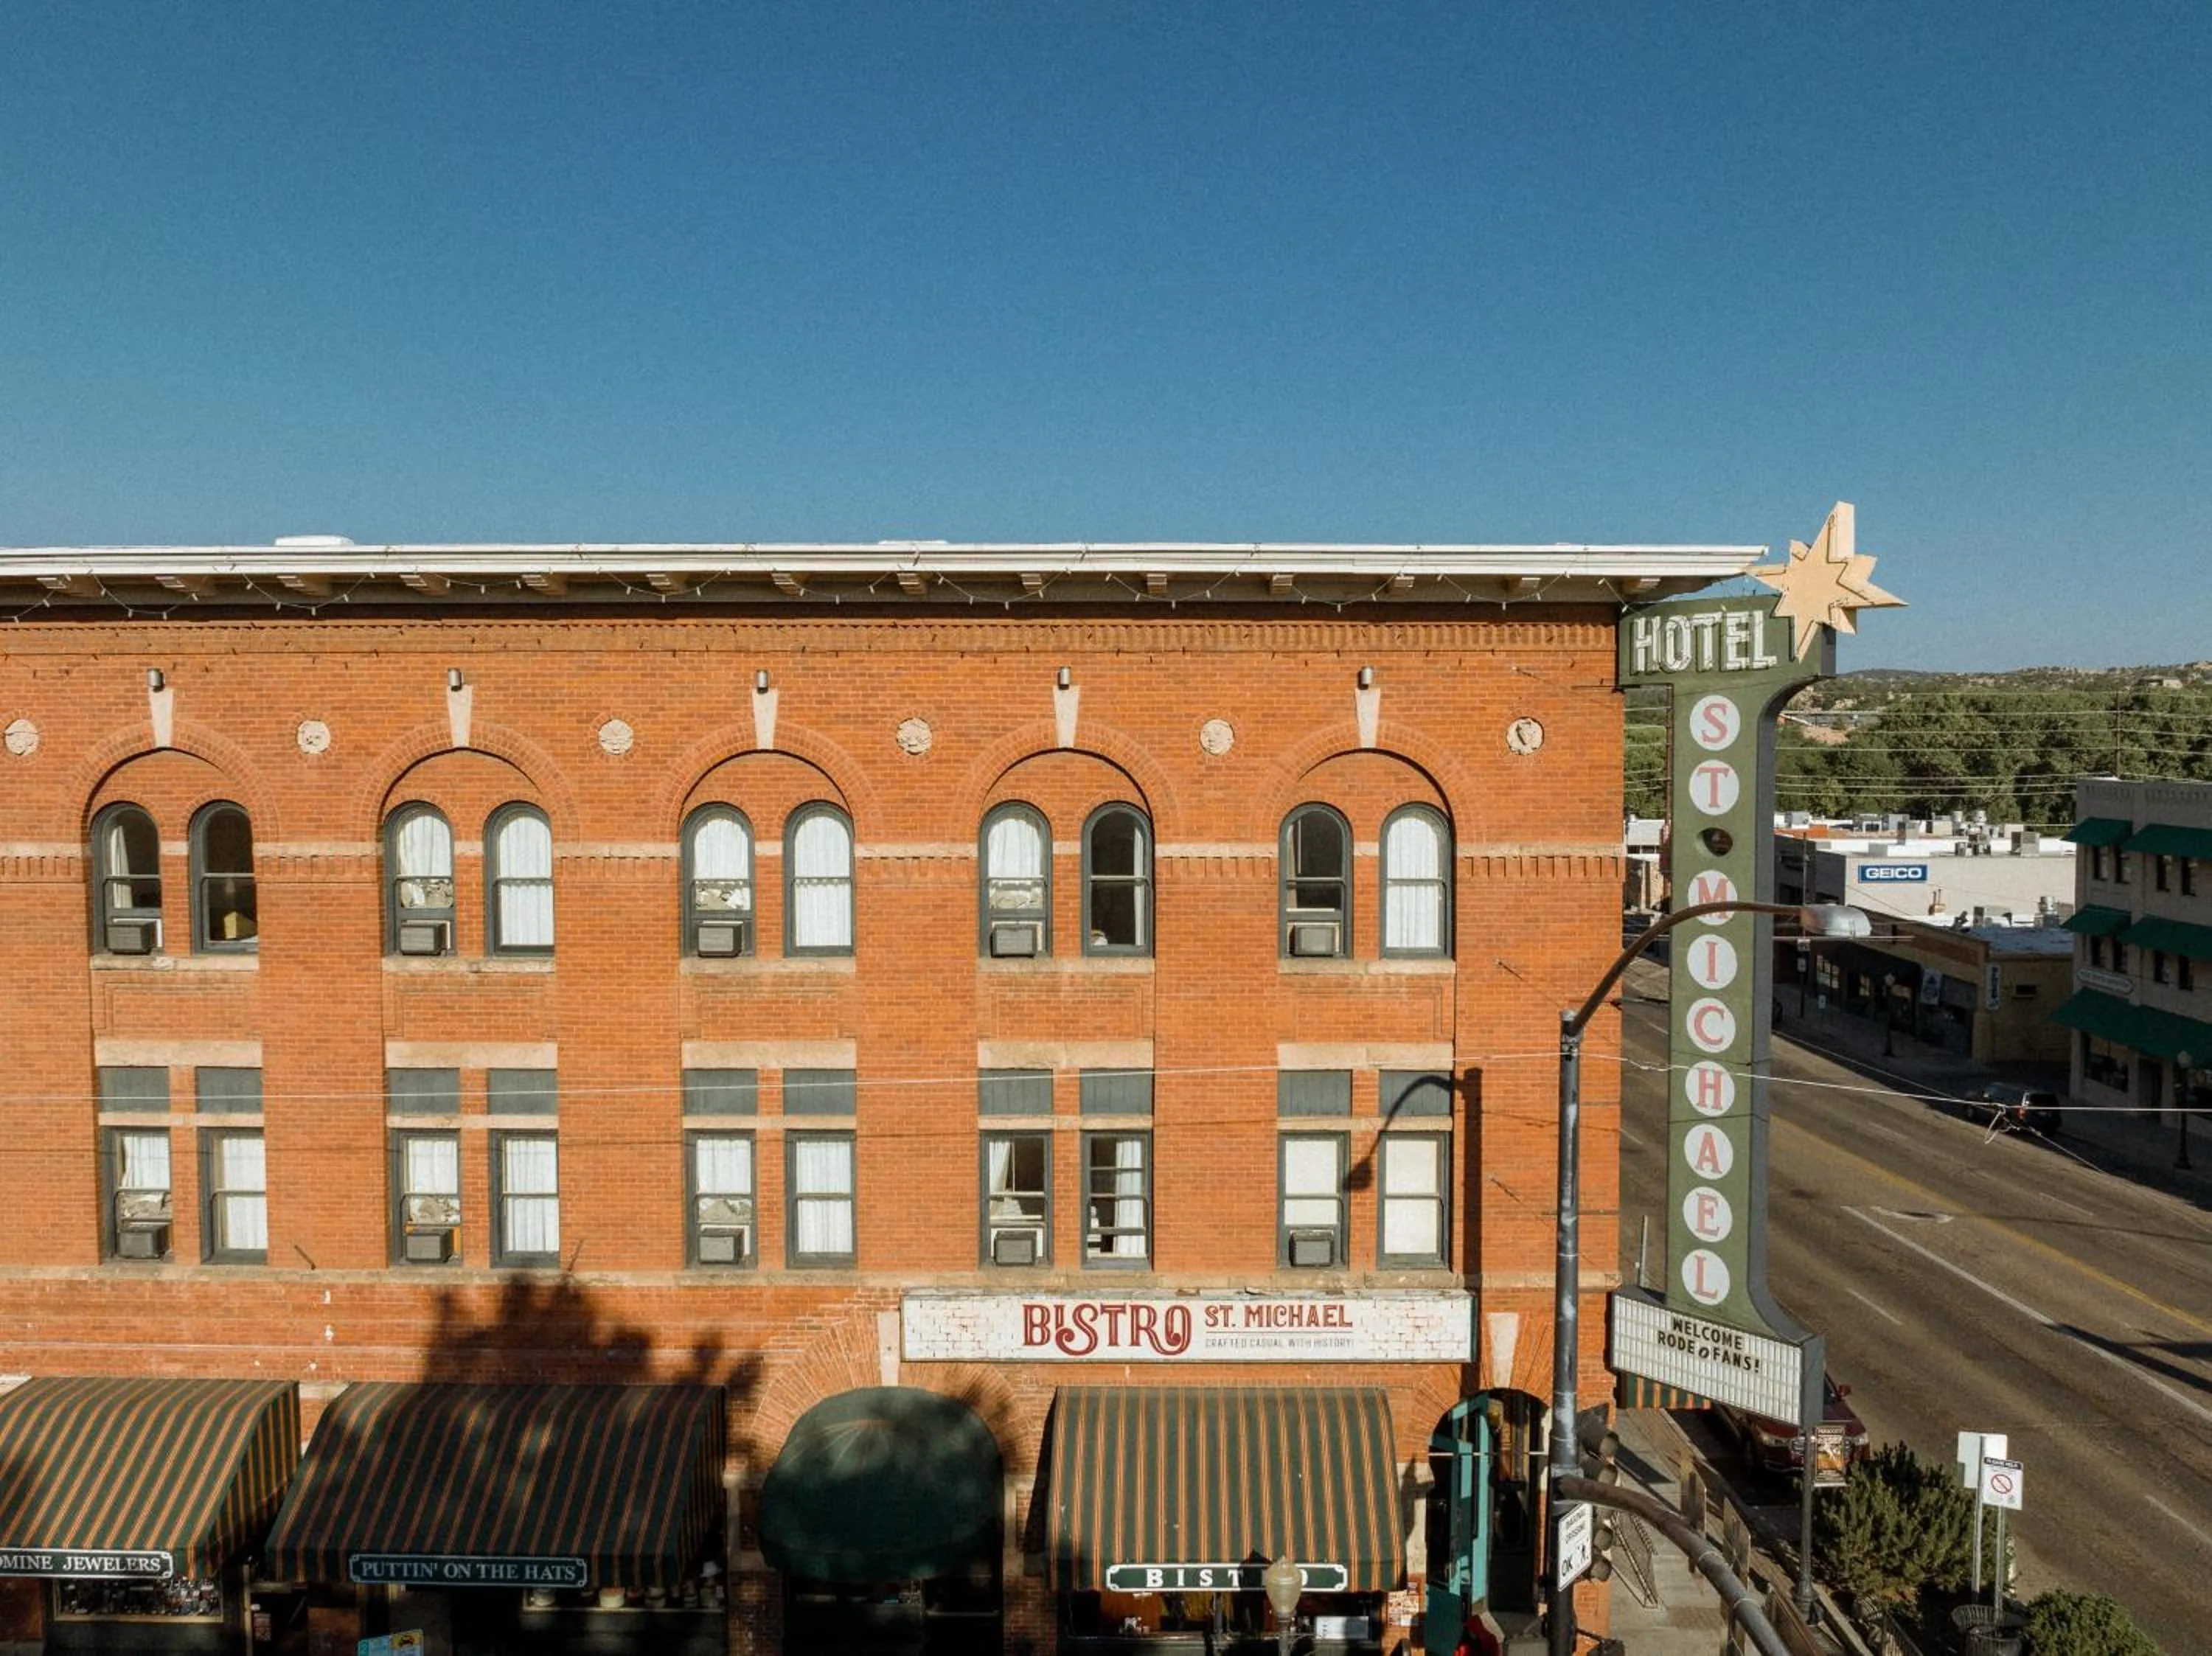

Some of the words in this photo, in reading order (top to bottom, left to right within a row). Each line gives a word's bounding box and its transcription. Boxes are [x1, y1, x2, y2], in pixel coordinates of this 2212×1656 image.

[1630, 610, 1778, 674] HOTEL
[1865, 867, 1922, 880] GEICO
[1693, 875, 1731, 1300] MICHAEL
[1204, 1304, 1237, 1328] ST.
[1244, 1304, 1354, 1328] MICHAEL
[1023, 1303, 1192, 1357] BISTRO
[1672, 1317, 1744, 1351] WELCOME
[1205, 1338, 1247, 1349] CRAFTED
[1249, 1338, 1283, 1349] CASUAL
[1713, 1346, 1761, 1374] FANS!
[0, 1554, 53, 1570] MINE
[62, 1556, 161, 1572] JEWELERS
[361, 1560, 438, 1579] PUTTIN'
[442, 1562, 473, 1579] ON
[476, 1562, 518, 1580] THE
[524, 1564, 577, 1581] HATS
[1561, 1554, 1573, 1577] OK
